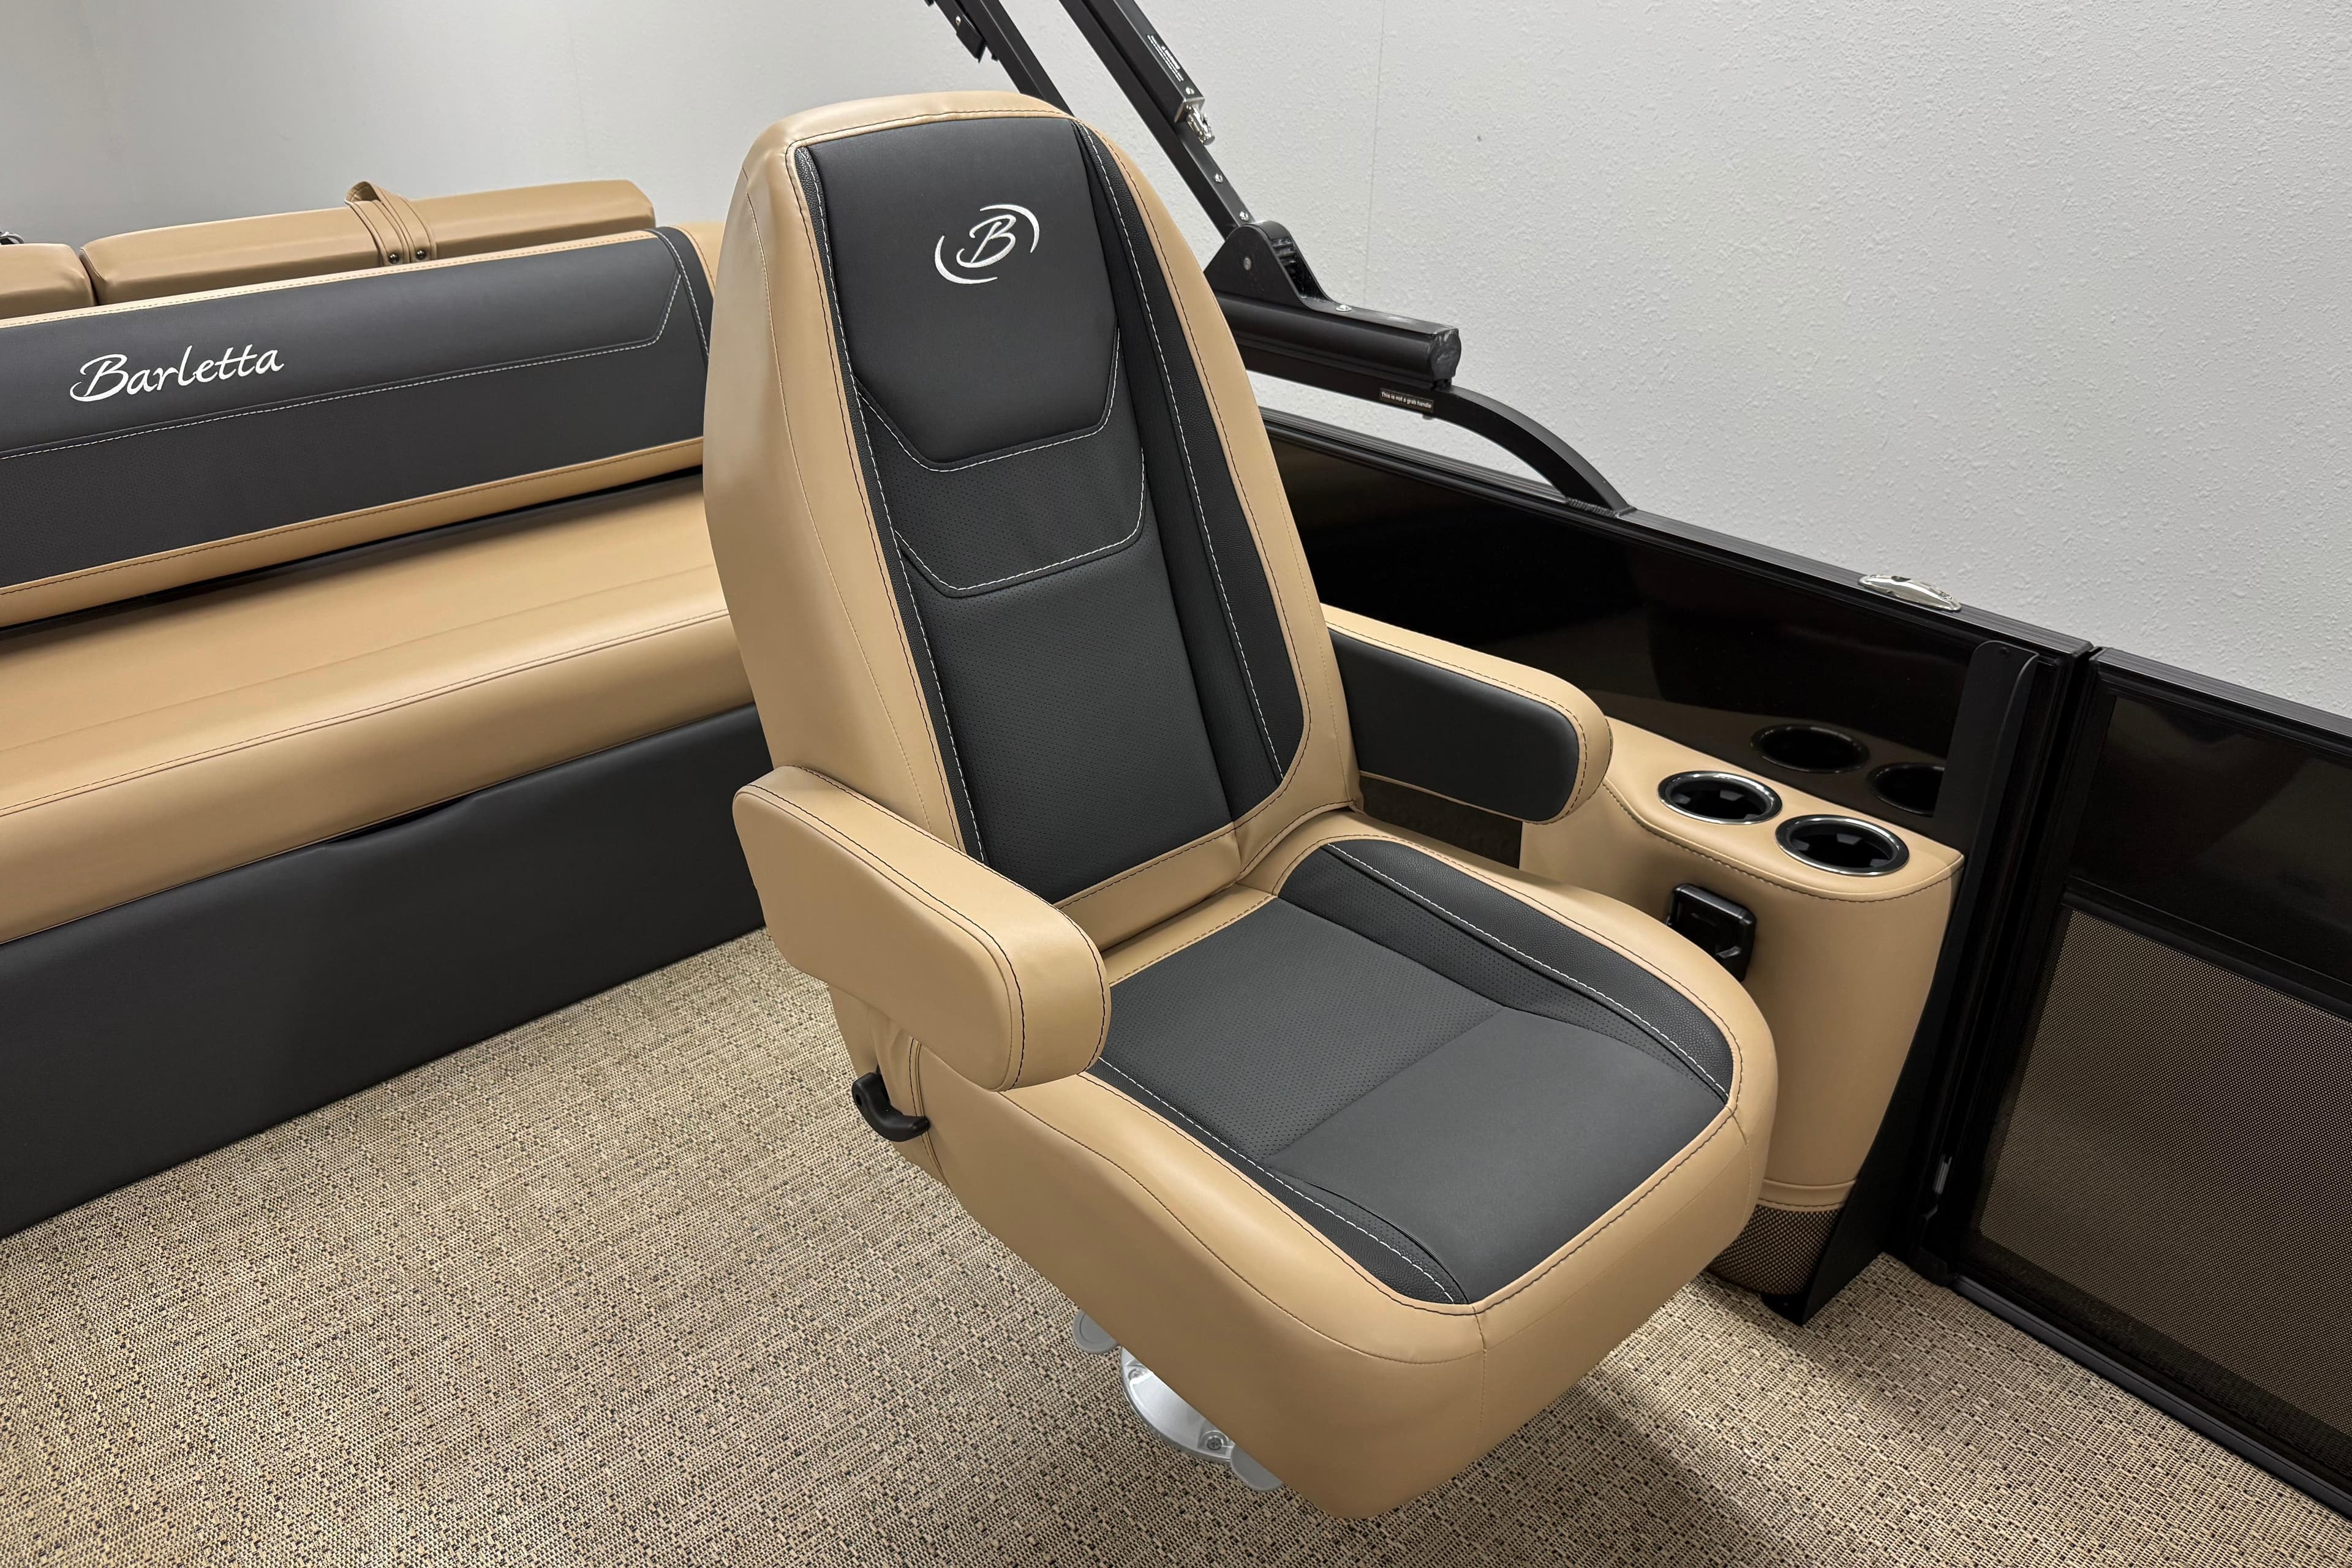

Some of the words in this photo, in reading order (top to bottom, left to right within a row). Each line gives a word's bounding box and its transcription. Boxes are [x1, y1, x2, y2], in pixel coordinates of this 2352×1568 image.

[956, 214, 1016, 268] B
[70, 344, 284, 402] Barletta
[1417, 400, 1431, 409] handle
